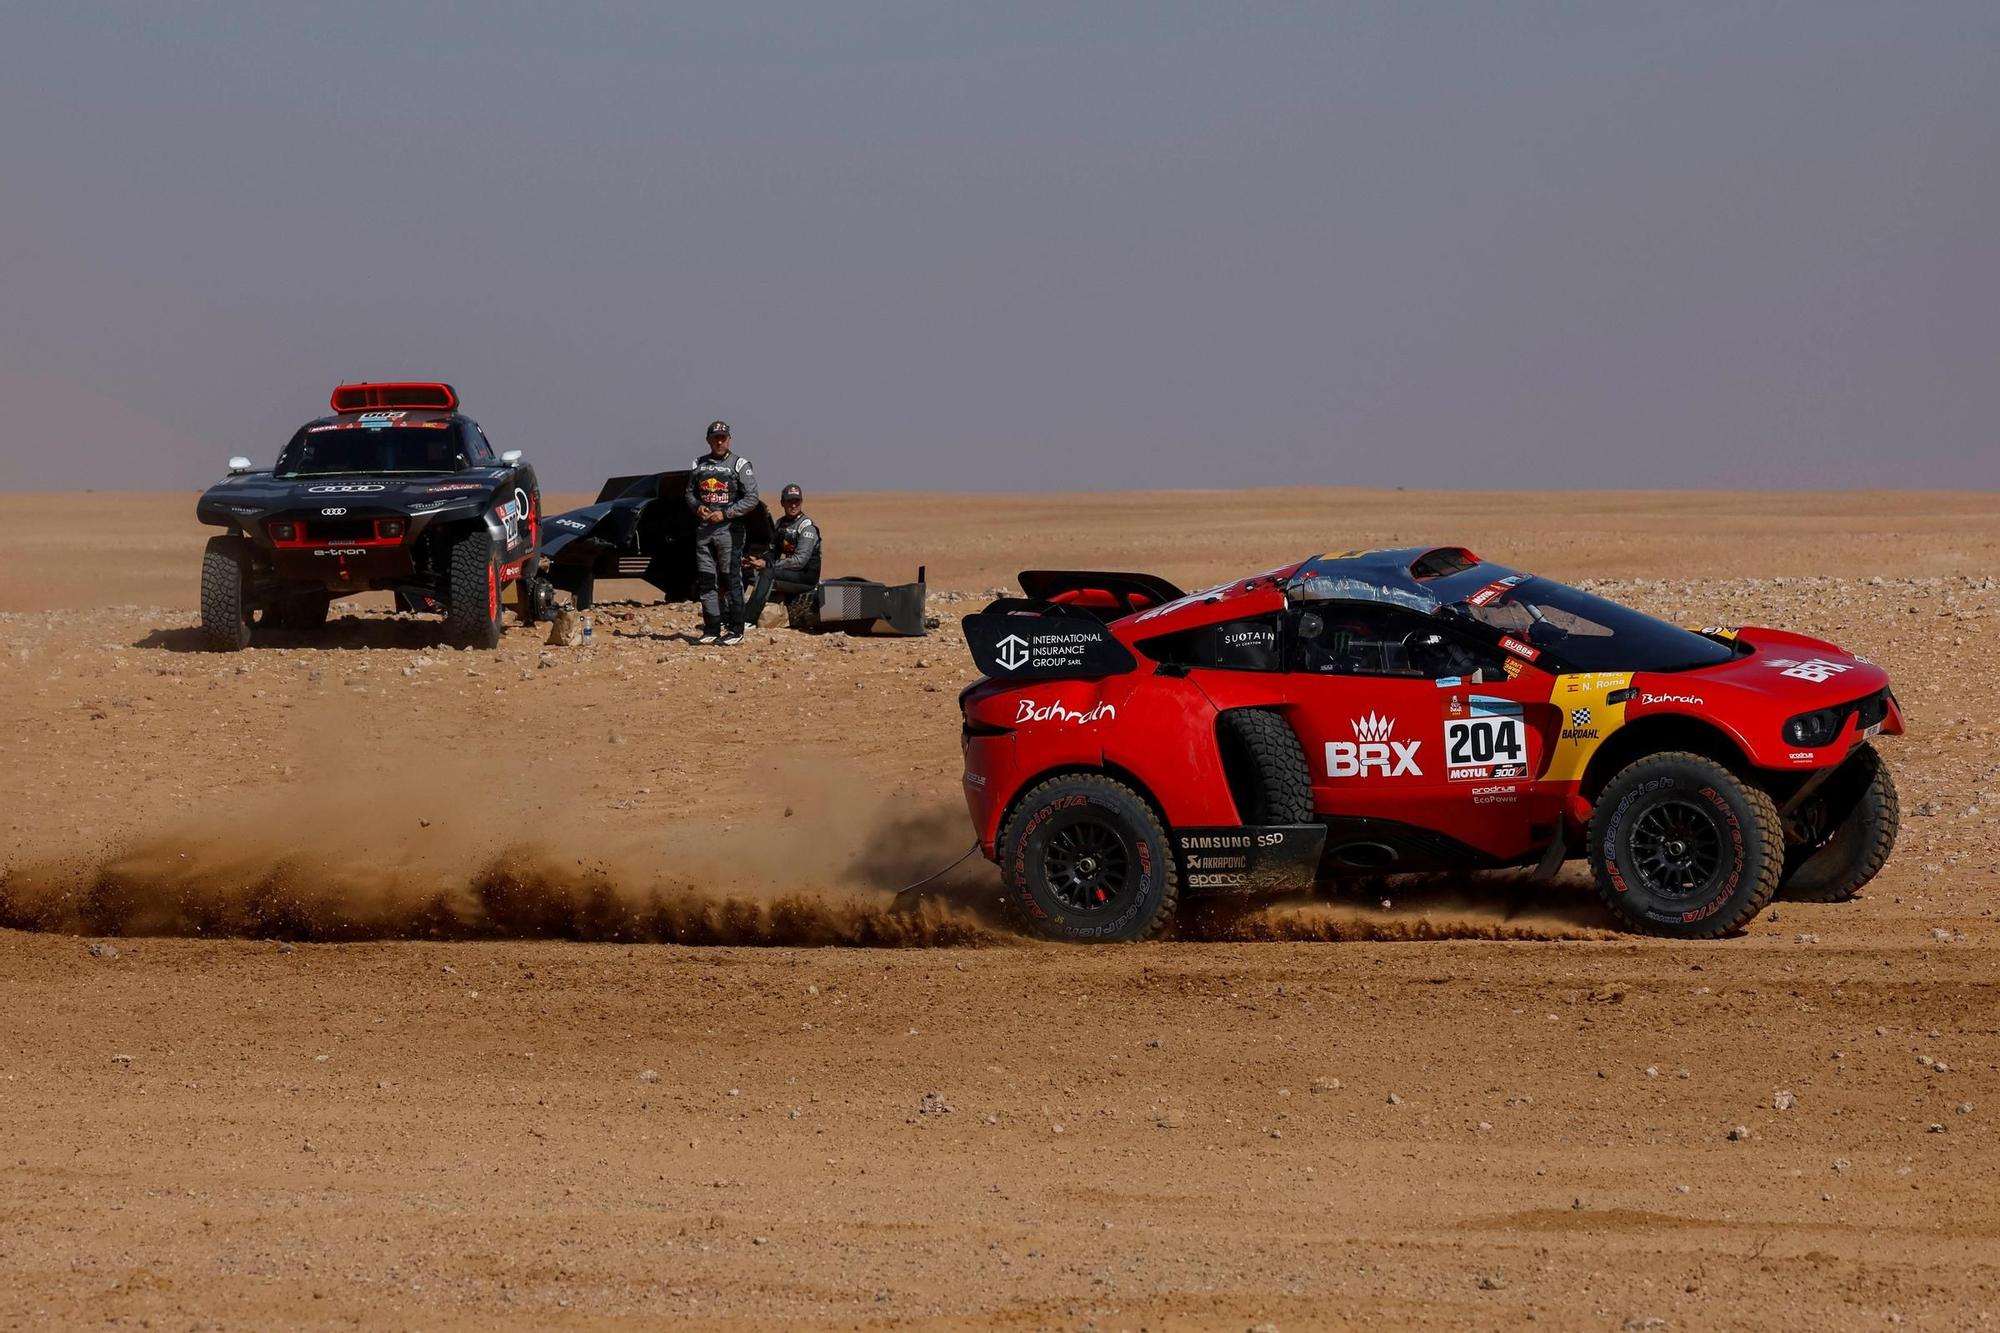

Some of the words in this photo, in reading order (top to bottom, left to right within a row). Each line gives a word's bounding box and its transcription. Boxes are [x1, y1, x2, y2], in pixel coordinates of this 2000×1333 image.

[1033, 633, 1102, 643] INTERNATIONAL
[1033, 646, 1085, 655] INSURANCE
[1032, 658, 1066, 667] GROUP
[1582, 682, 1592, 691] N.
[1596, 679, 1625, 688] Roma
[1642, 693, 1704, 705] Bahrain
[1016, 700, 1115, 724] Bahrain
[1562, 729, 1599, 739] BARDAHL
[1450, 721, 1521, 763] 204
[1325, 741, 1423, 777] BRX
[1450, 768, 1488, 779] MOTUL
[1181, 837, 1251, 848] SAMSUNG
[1257, 833, 1284, 847] SSD
[1188, 873, 1247, 888] sparco
